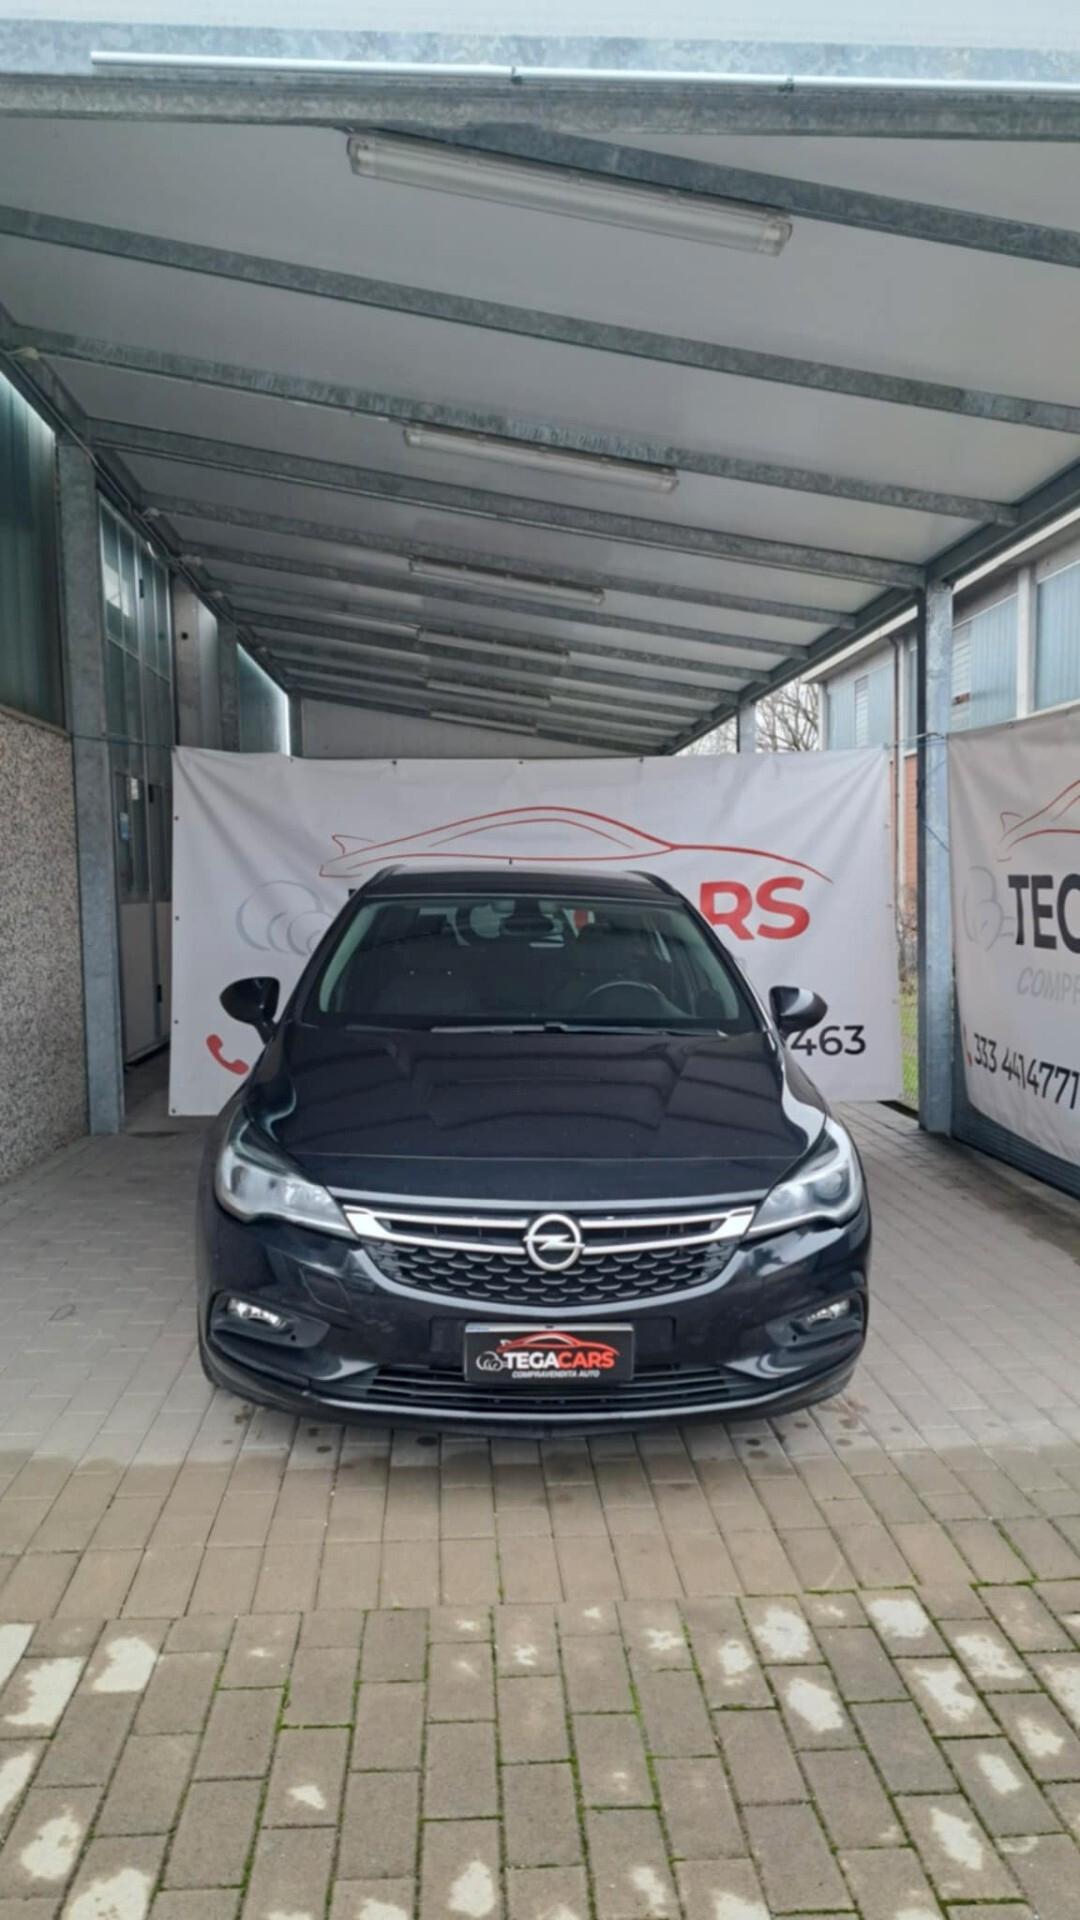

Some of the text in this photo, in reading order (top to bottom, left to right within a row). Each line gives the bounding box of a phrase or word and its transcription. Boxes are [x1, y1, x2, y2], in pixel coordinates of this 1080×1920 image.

[974, 1032, 997, 1073] 333
[504, 1352, 615, 1370] TEGACARS
[579, 1370, 600, 1378] AUTO
